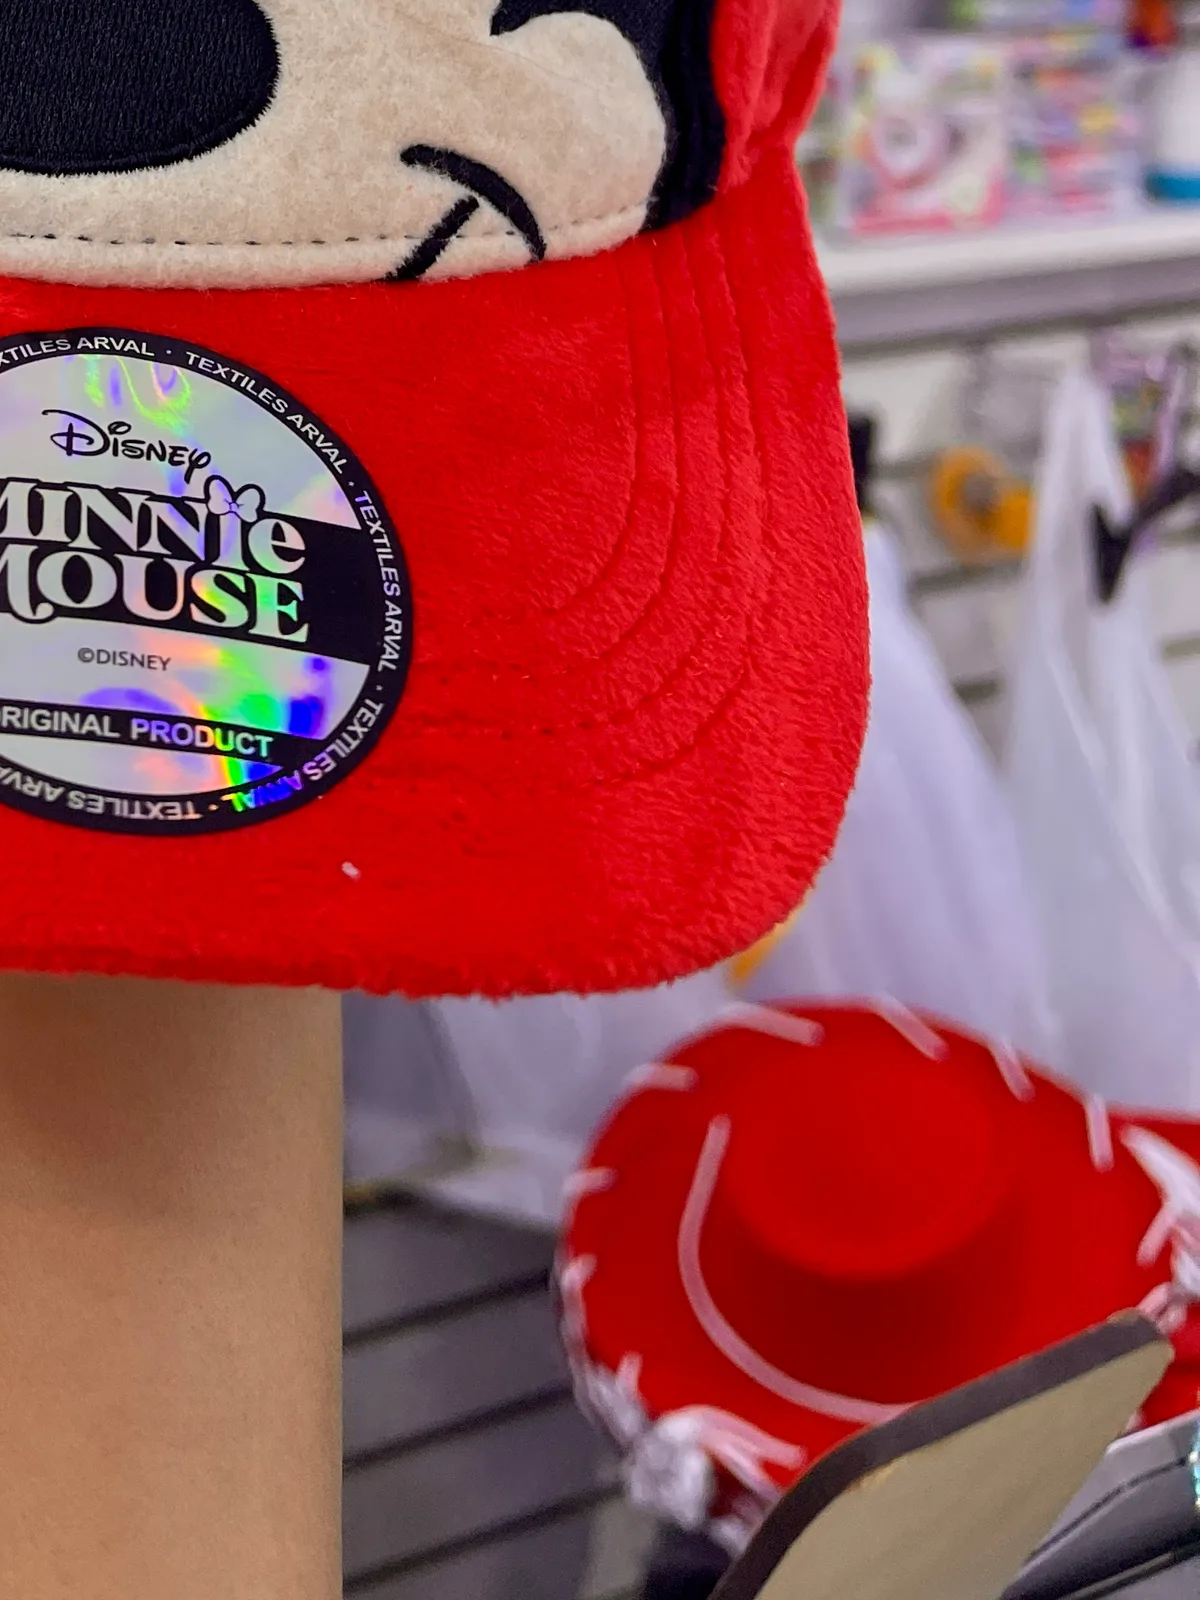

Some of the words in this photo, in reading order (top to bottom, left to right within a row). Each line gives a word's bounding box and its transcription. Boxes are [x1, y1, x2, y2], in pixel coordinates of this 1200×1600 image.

[76, 335, 155, 356] ARVAL
[185, 350, 289, 414] TEXTILES
[286, 411, 349, 475] ARVAL
[355, 489, 402, 597] TEXTILES
[377, 600, 403, 673] ARVAL
[76, 646, 172, 673] ©DISNEY
[130, 717, 274, 758] PRODUCT
[302, 698, 384, 781] TEXTILES
[67, 788, 203, 821] TEXTILES
[220, 768, 303, 813] ARVAL
